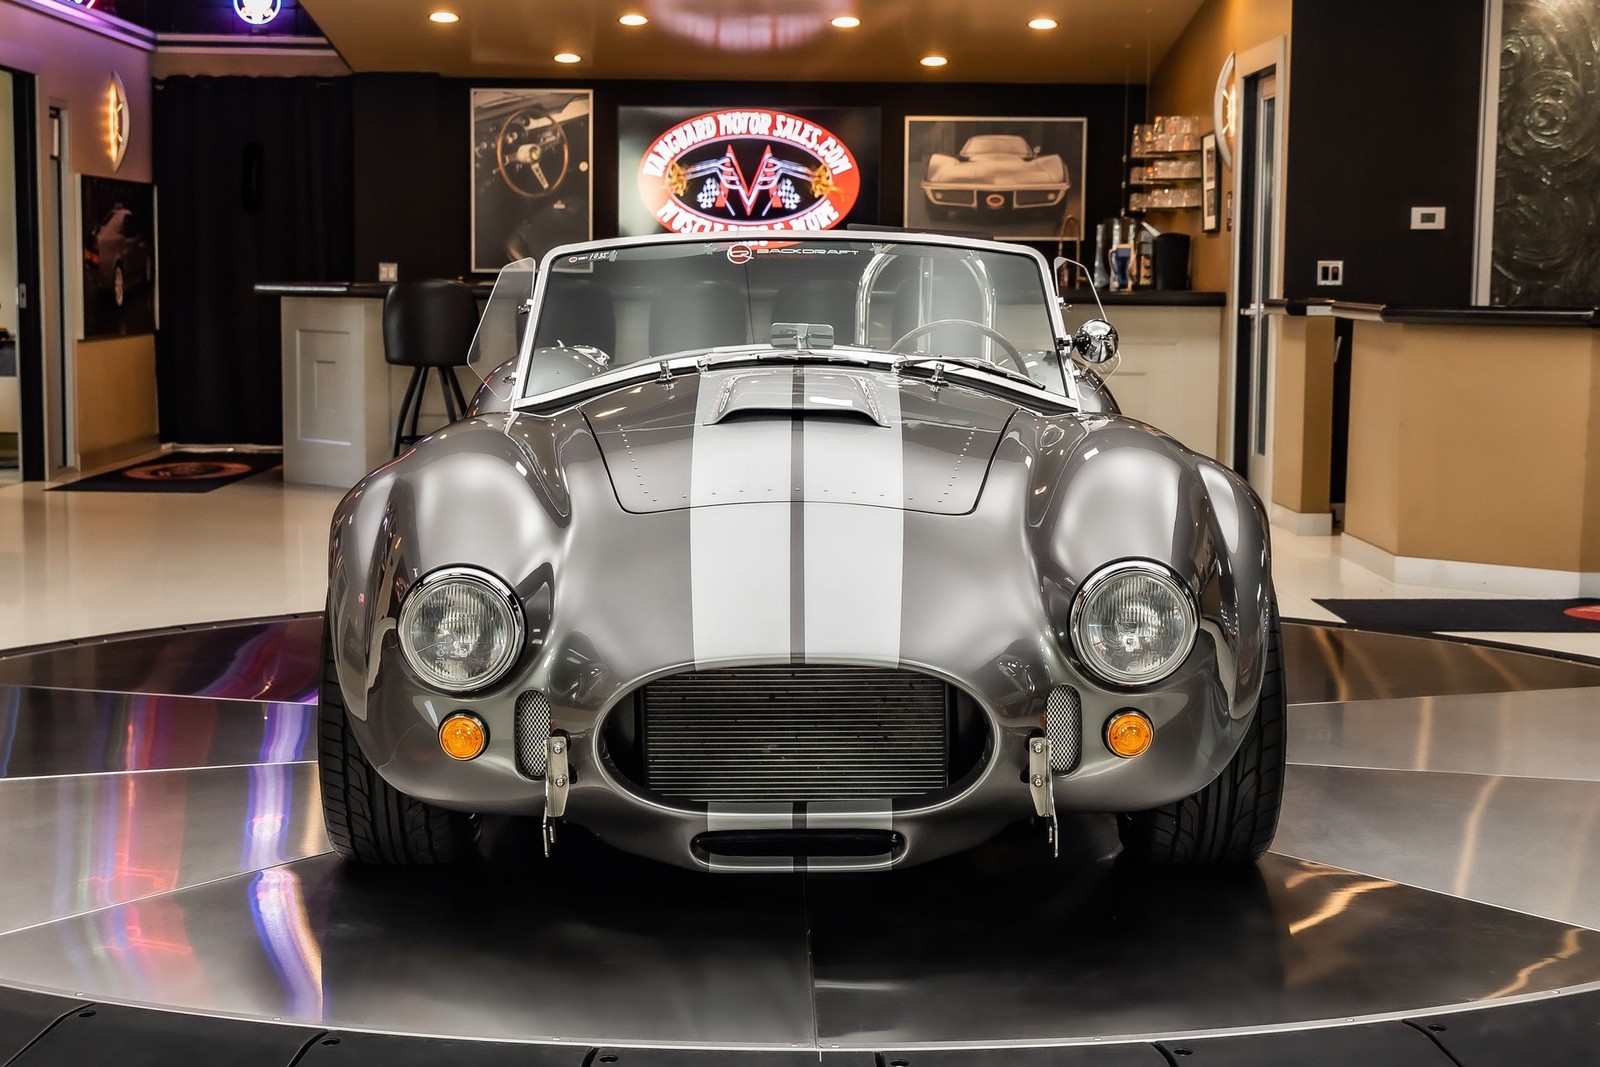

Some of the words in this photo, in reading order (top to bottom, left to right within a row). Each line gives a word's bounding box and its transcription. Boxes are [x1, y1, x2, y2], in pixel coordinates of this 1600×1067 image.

[643, 114, 717, 177] VANGUARD
[717, 112, 772, 136] MOTOR
[773, 115, 852, 175] SALES.COM
[757, 248, 859, 256] BACKDRAFT
